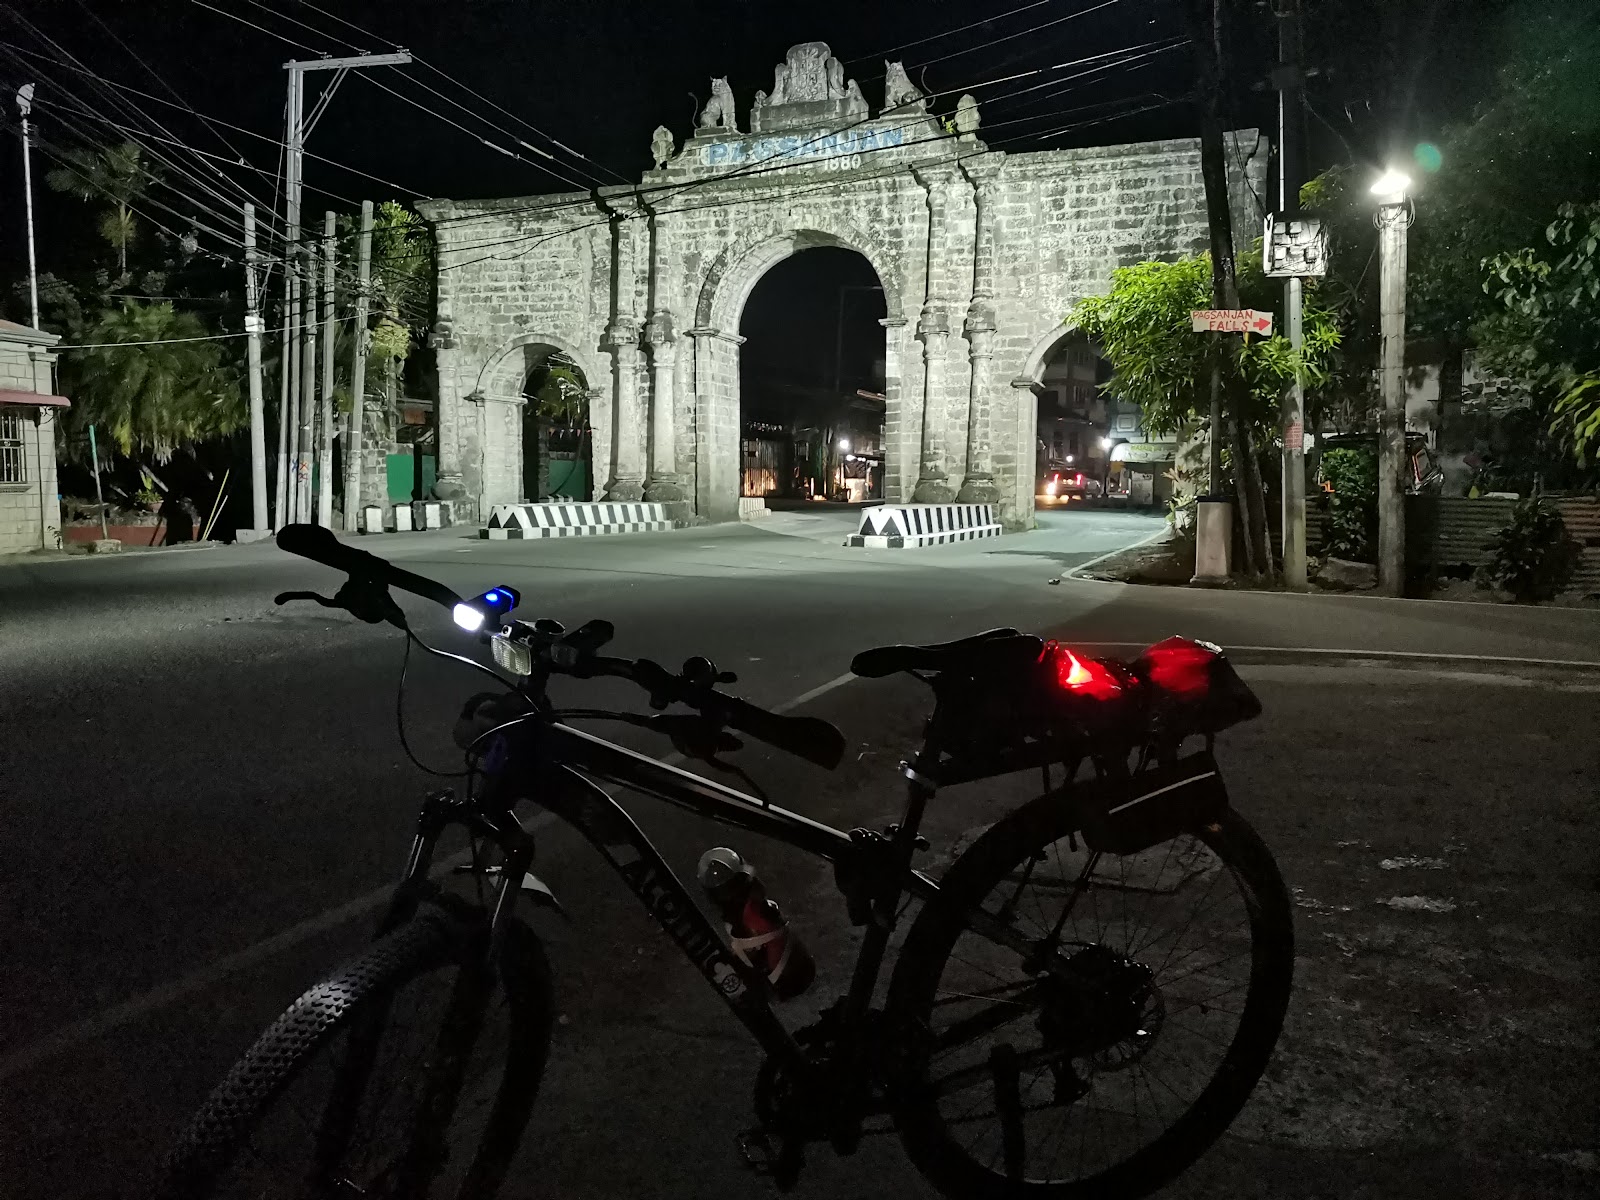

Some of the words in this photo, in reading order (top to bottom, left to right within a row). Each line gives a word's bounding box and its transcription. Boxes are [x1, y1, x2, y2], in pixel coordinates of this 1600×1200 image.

[824, 154, 861, 171] 1880
[1192, 310, 1253, 320] PAGSANJAN
[1209, 320, 1250, 332] FALLS
